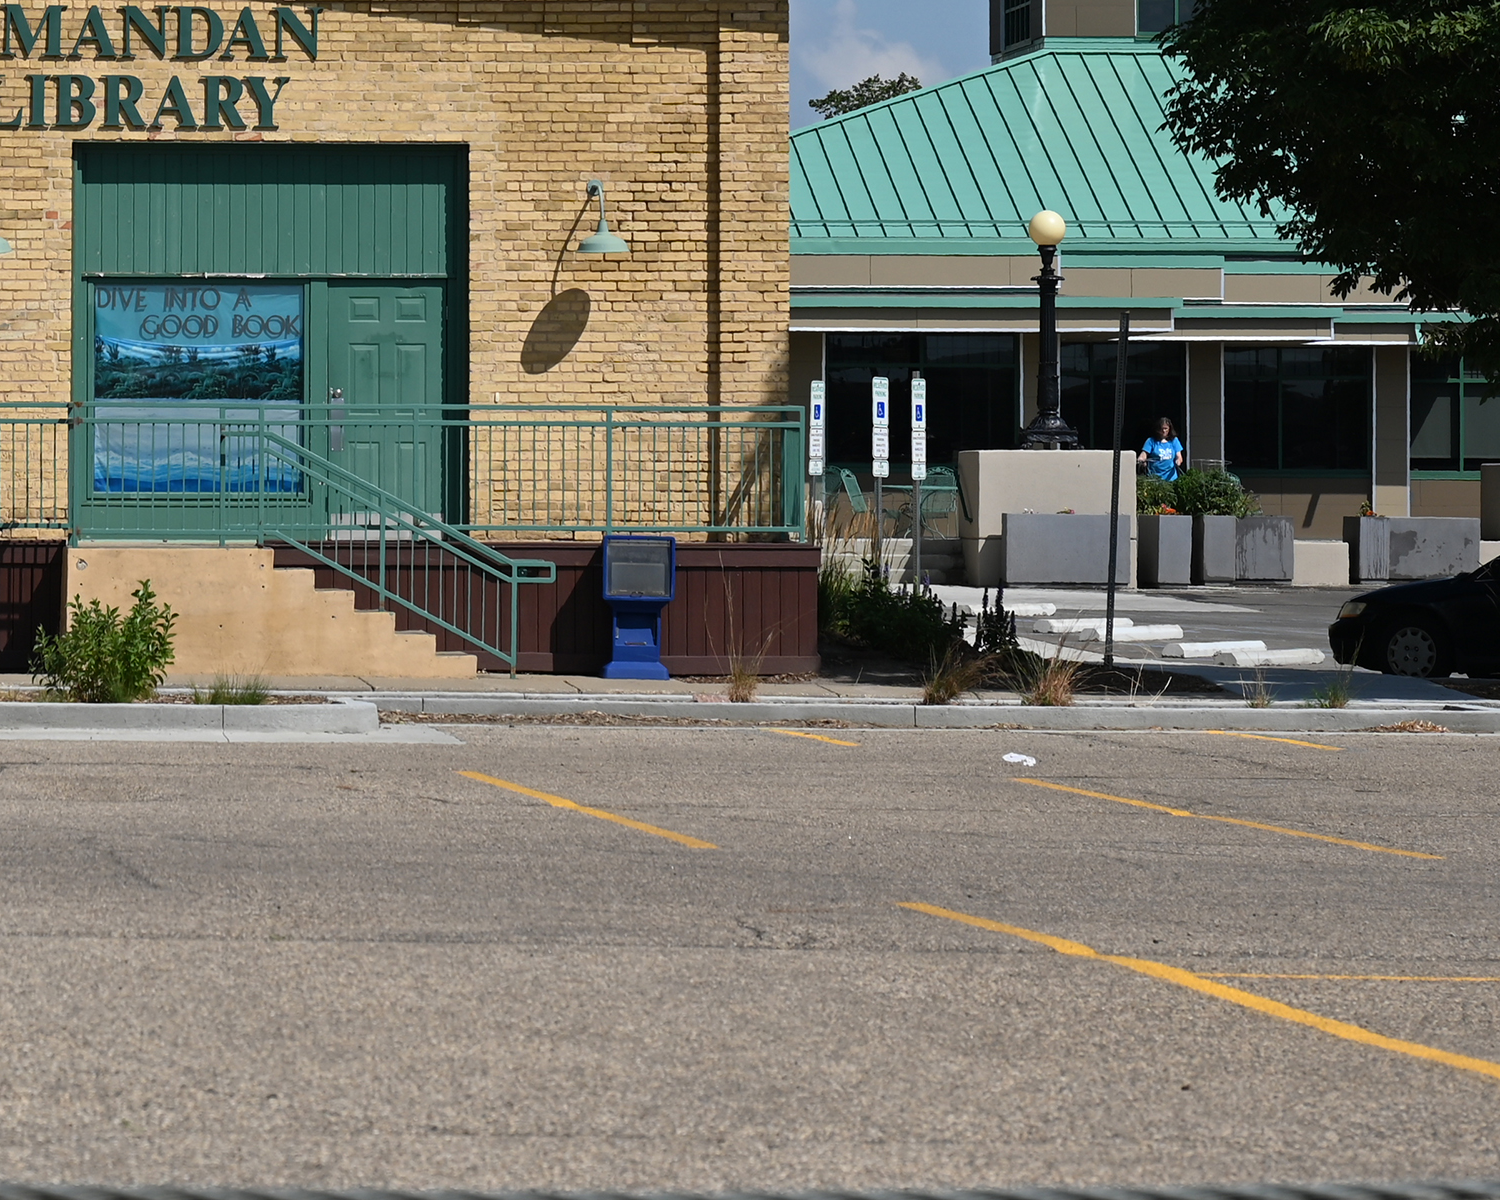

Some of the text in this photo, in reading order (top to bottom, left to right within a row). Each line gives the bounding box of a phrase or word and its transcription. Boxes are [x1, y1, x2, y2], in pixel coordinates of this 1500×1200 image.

[97, 287, 251, 311] DIVE INTO A
[141, 314, 300, 338] GOOD BOOK
